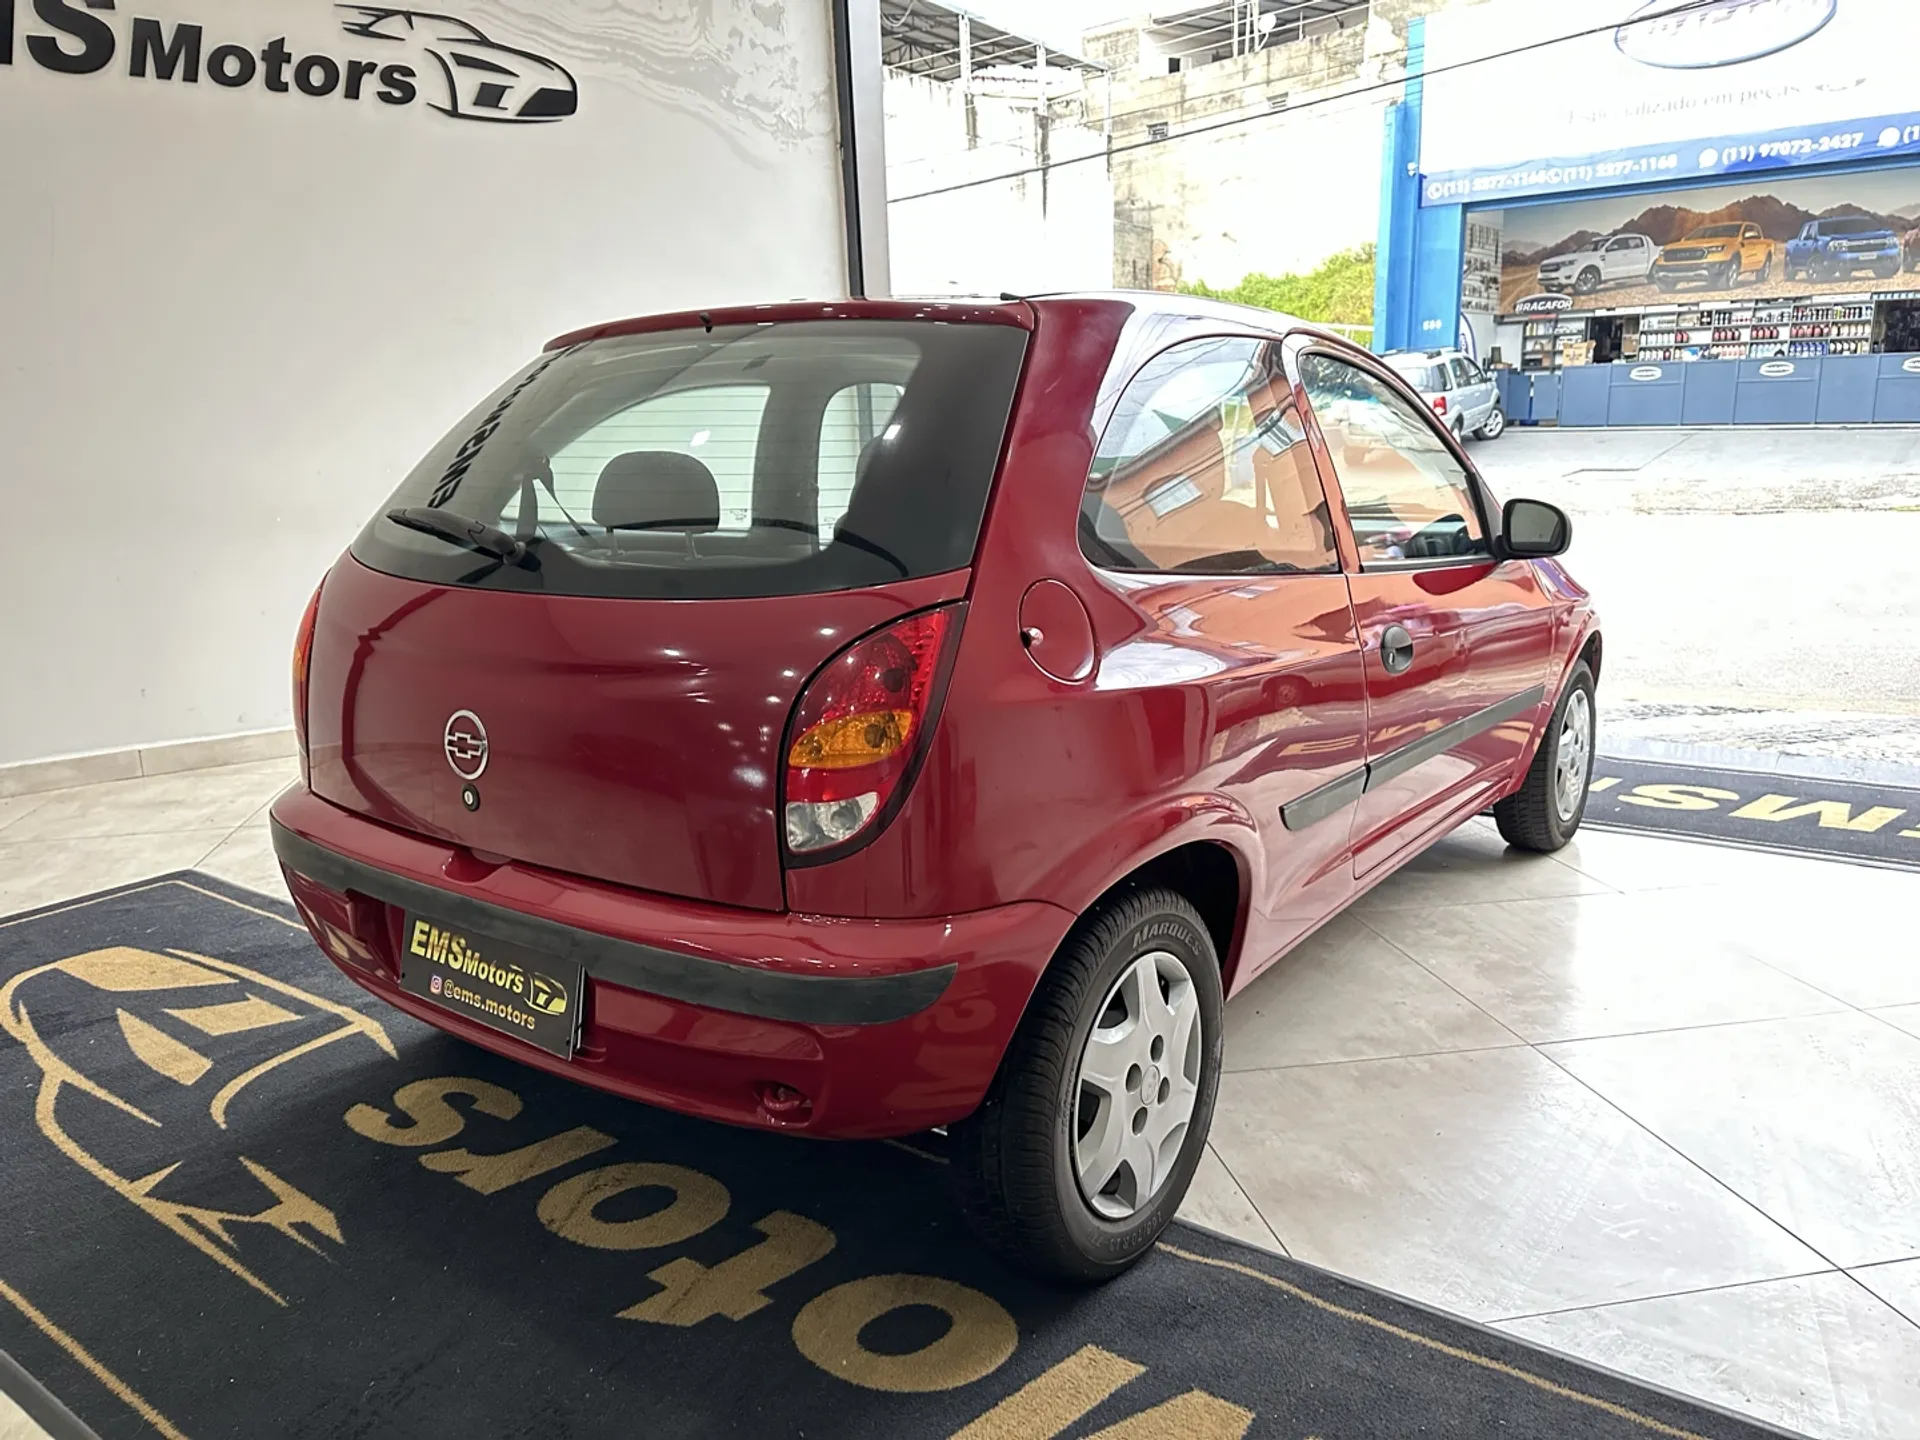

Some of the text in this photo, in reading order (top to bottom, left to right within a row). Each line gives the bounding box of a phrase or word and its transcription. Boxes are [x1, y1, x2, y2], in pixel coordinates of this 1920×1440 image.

[129, 17, 417, 105] Motors
[1722, 145, 1755, 166] (11)
[1617, 783, 1920, 838] MS
[443, 978, 536, 1031] @ems.motors
